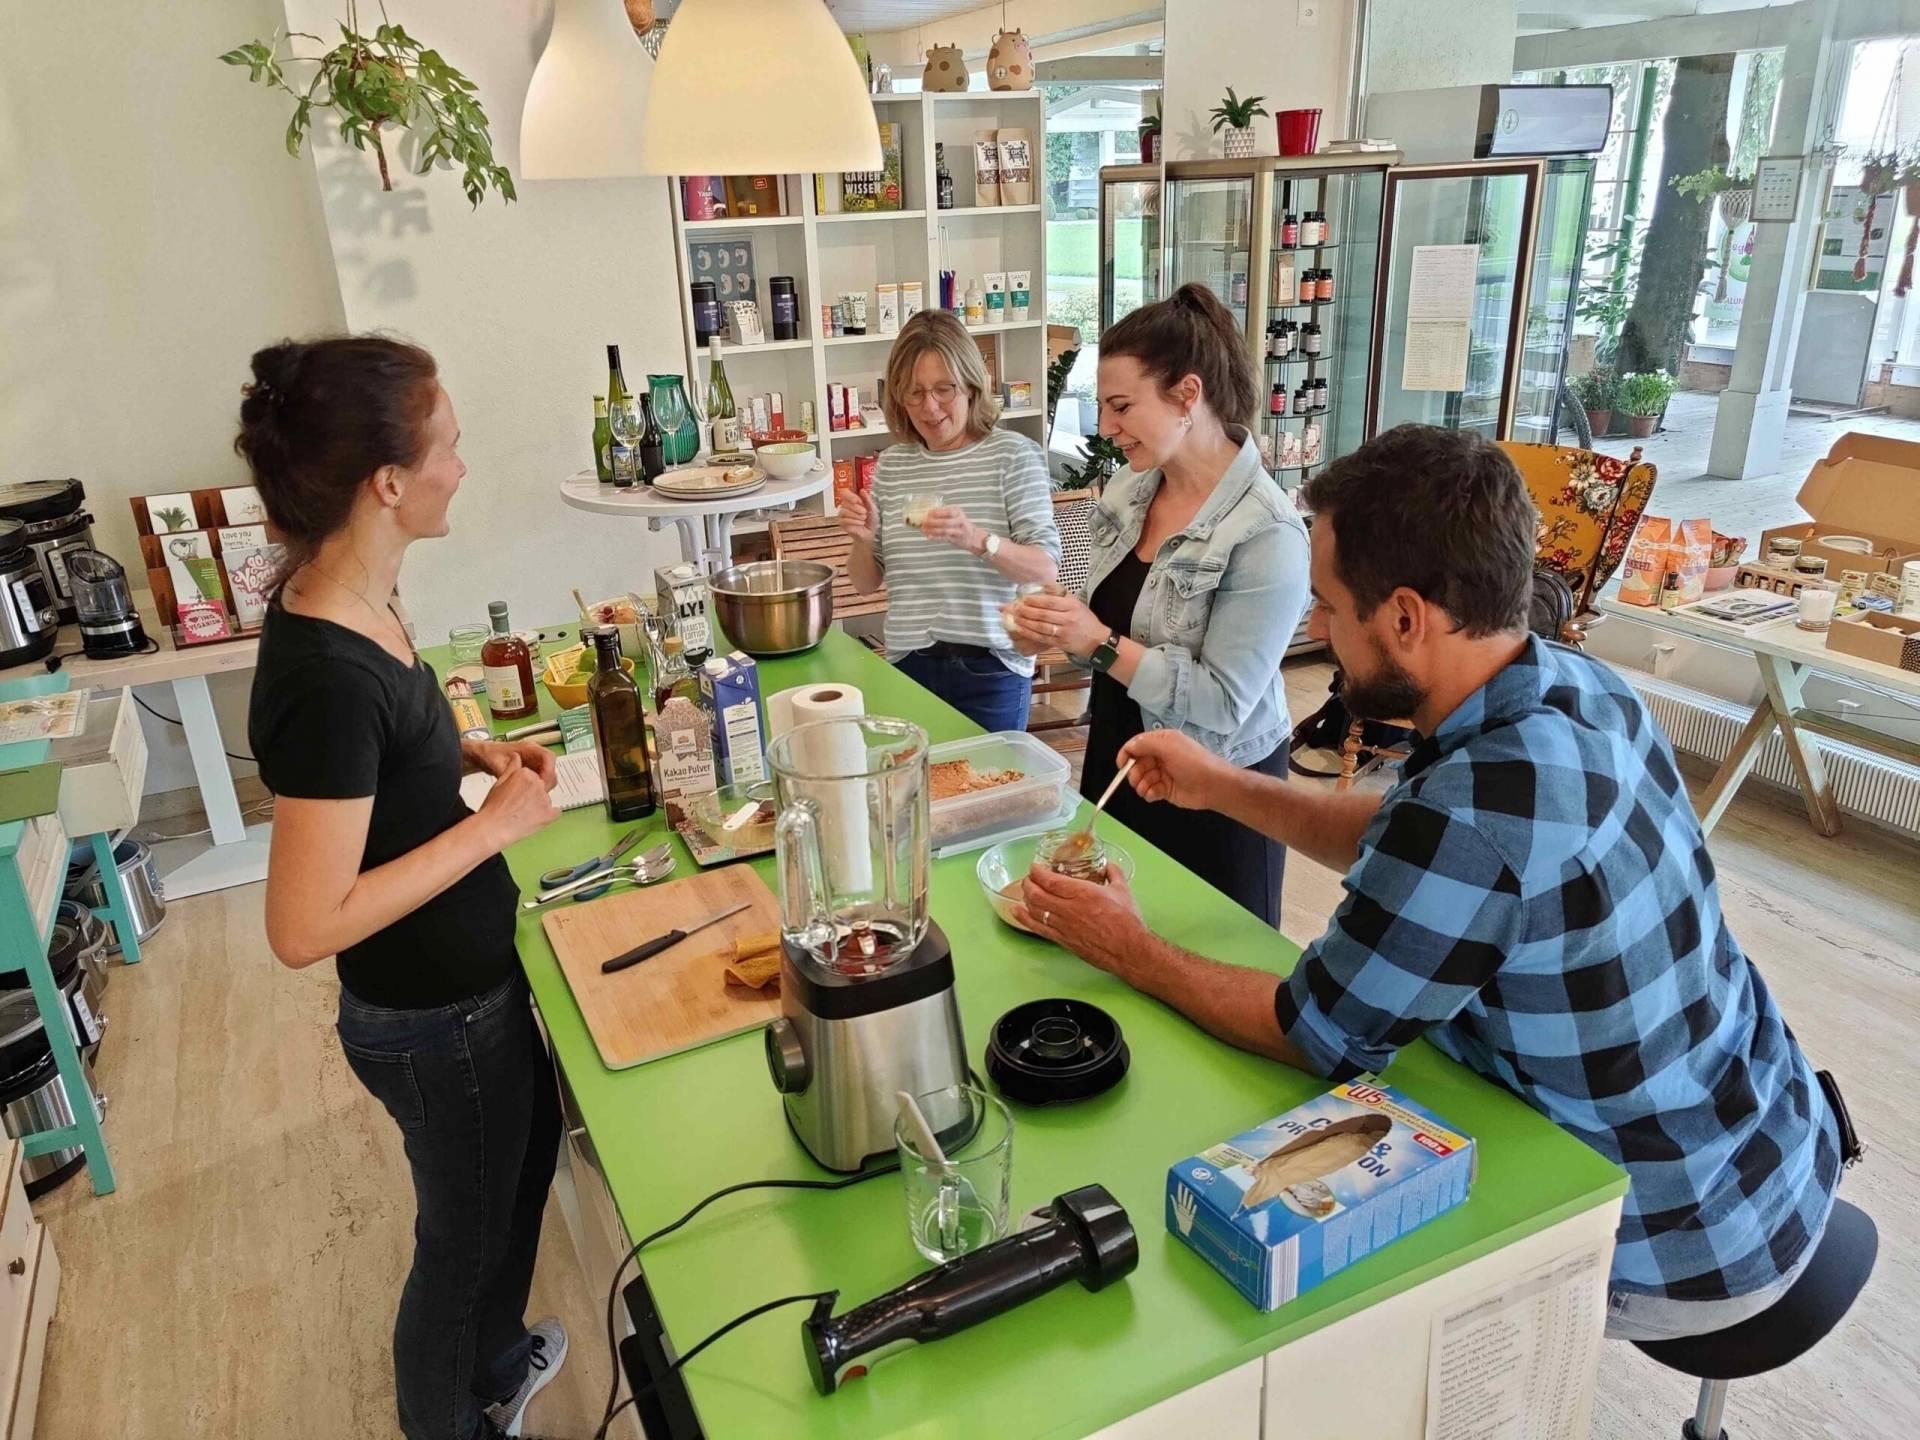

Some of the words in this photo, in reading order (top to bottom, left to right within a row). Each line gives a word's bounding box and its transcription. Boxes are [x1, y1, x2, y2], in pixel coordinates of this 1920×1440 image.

[845, 182, 880, 194] WISSEN
[680, 600, 705, 618] LY!
[664, 767, 687, 778] Kakao
[688, 764, 711, 776] Pulver
[1346, 1085, 1389, 1105] W5
